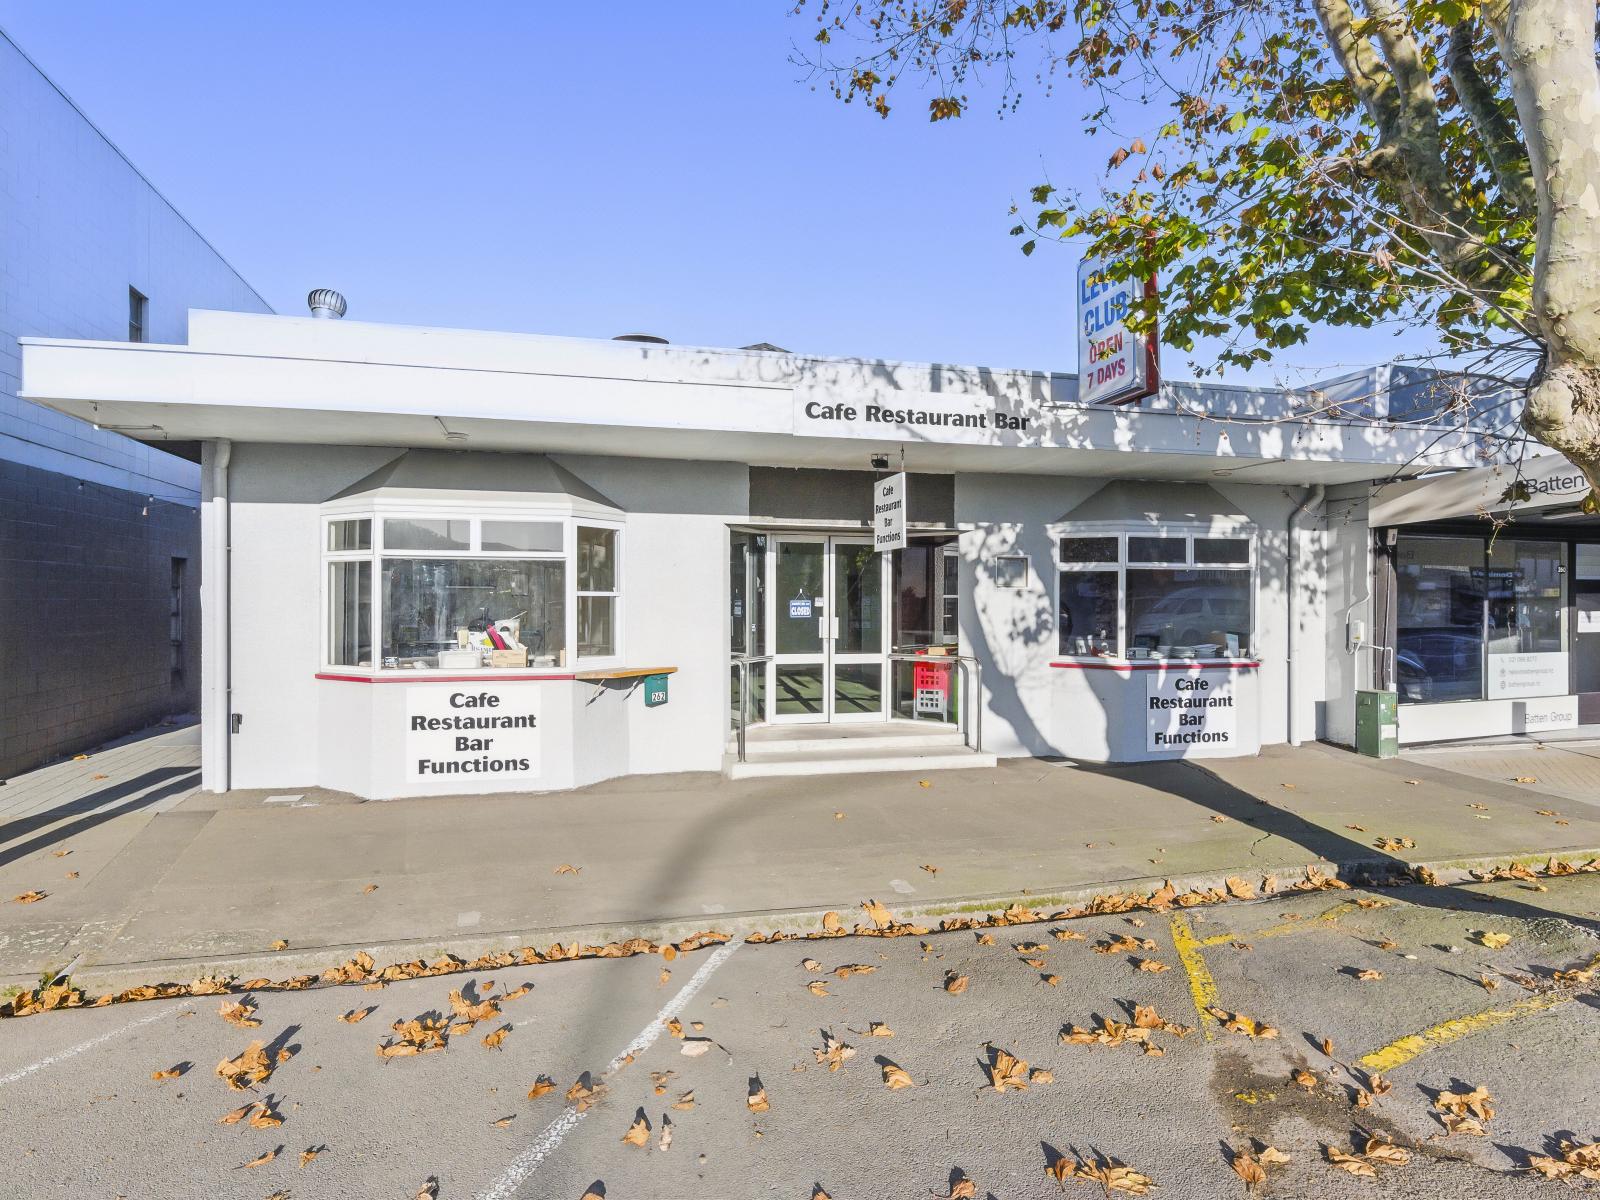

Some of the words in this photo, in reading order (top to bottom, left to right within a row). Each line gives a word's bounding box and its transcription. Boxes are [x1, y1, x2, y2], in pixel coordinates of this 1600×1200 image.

[1084, 290, 1128, 336] CLUB
[1087, 371, 1094, 389] 7
[1097, 358, 1126, 384] DAYS
[805, 401, 857, 421] Cafe
[865, 405, 987, 428] Restaurant
[994, 412, 1031, 430] Bar
[882, 485, 894, 497] Cafe
[1526, 475, 1585, 494] Batten
[875, 500, 902, 515] Restaurant
[884, 517, 893, 528] Bar
[876, 531, 901, 545] Functions
[791, 606, 811, 616] CLOSED
[1175, 678, 1209, 691] Cafe
[449, 692, 500, 708] Cafe
[653, 692, 665, 701] 262
[1149, 696, 1233, 709] Restaurant
[411, 714, 537, 731] Restaurant
[1179, 713, 1204, 726] Bar
[1525, 713, 1548, 724] Batten
[1550, 711, 1573, 722] Group
[455, 736, 494, 752] Bar
[1154, 729, 1229, 745] Functions
[418, 755, 530, 775] Functions
